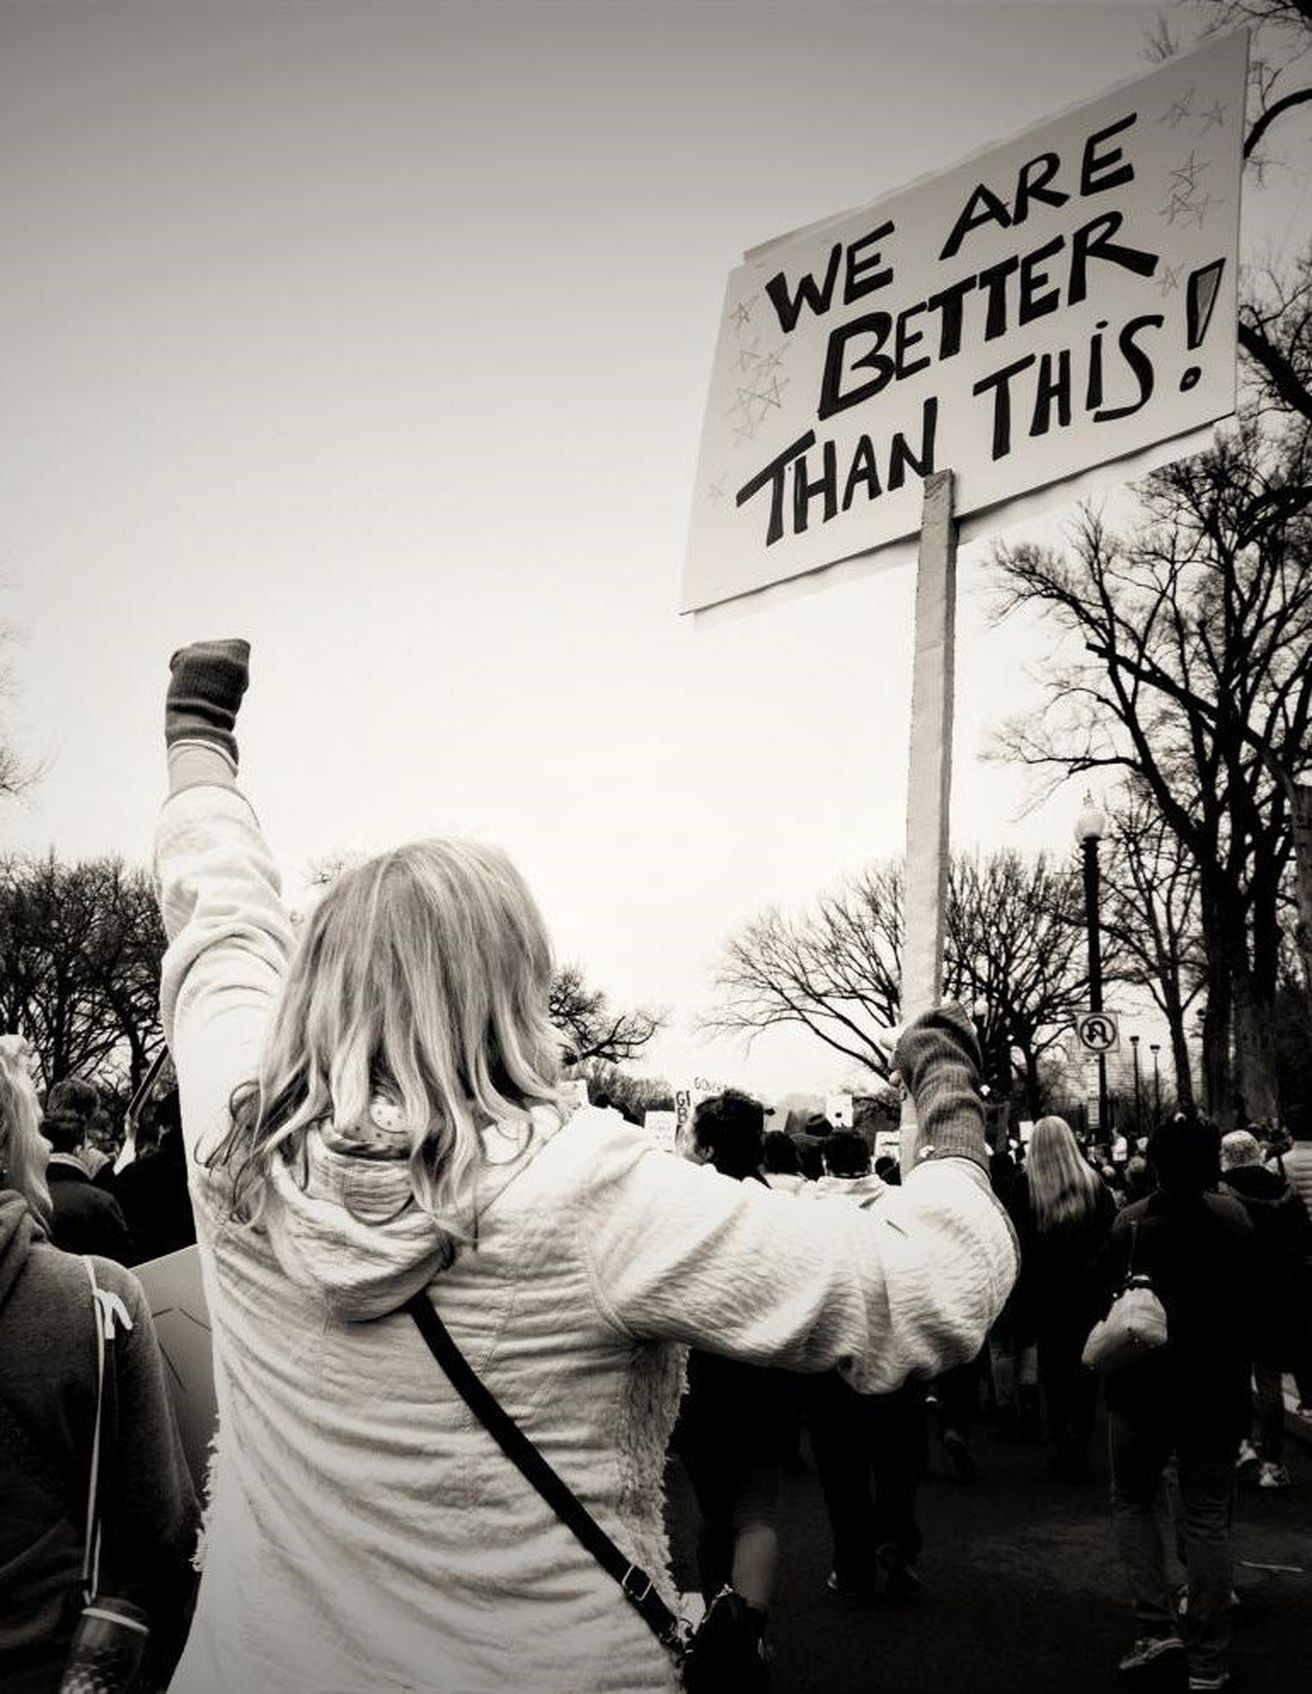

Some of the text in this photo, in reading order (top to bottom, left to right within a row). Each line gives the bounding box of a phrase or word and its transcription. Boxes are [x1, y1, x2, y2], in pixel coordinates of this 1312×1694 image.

[764, 111, 1138, 334] WE ARE
[817, 210, 1160, 422] BETTER
[735, 396, 938, 547] THAN
